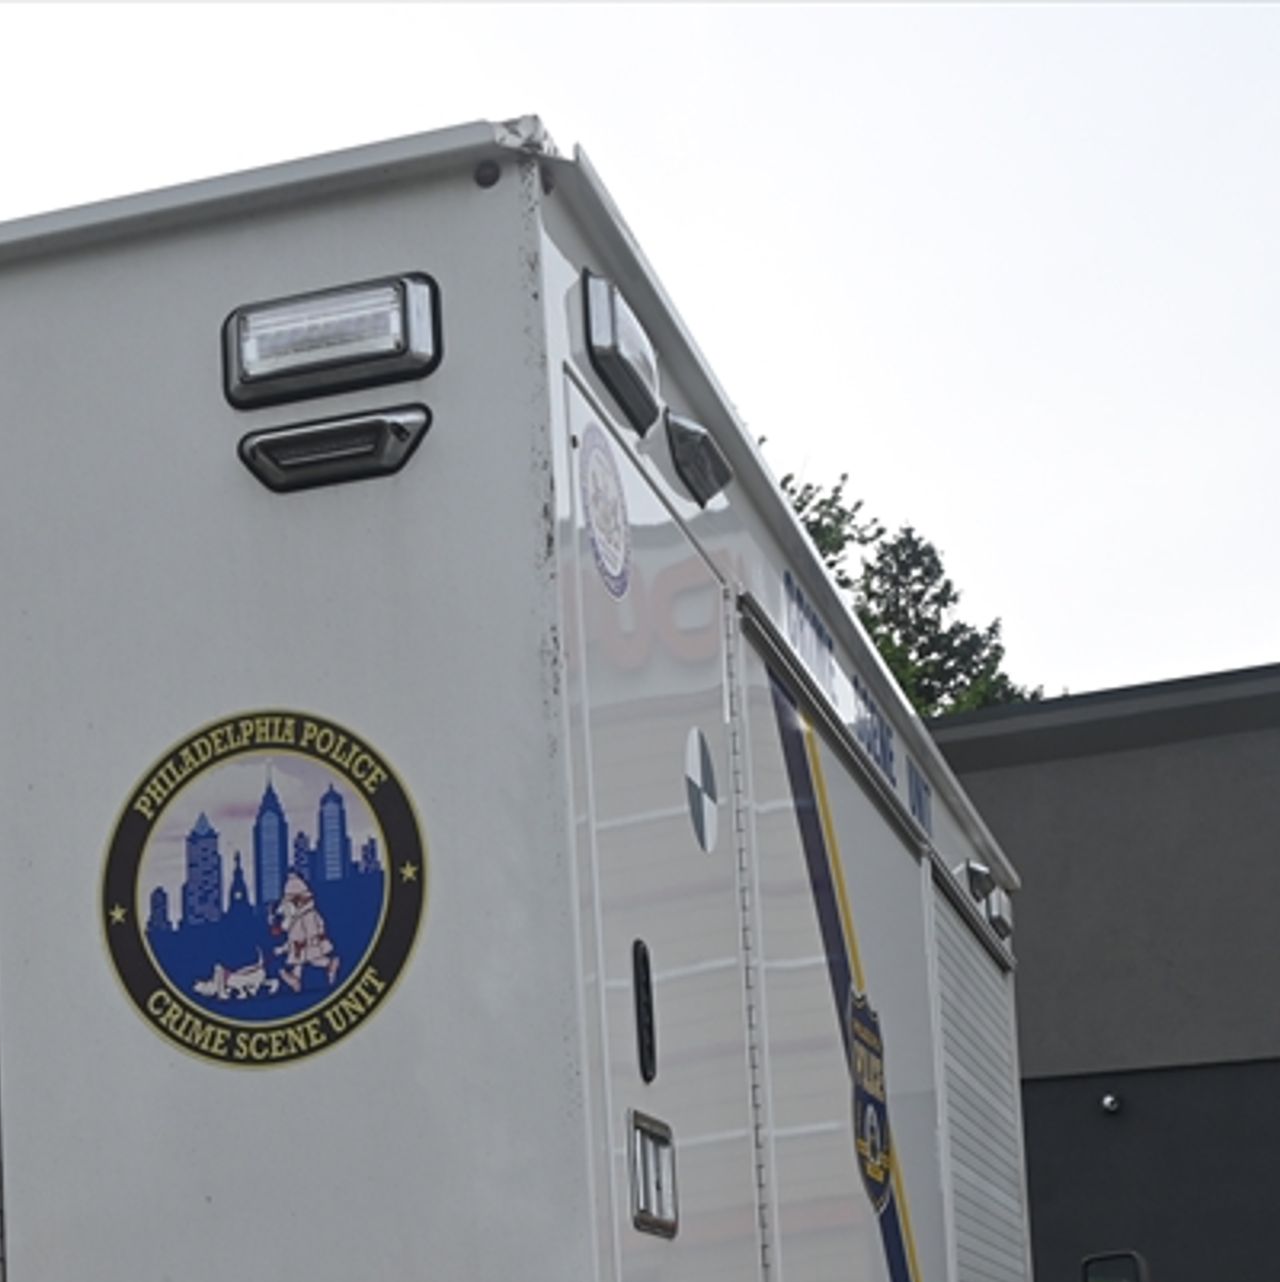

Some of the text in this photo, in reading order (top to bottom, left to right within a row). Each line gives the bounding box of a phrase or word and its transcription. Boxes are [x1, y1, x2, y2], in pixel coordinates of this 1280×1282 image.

[133, 716, 389, 820] PHILADELPHIA POLICE
[145, 966, 388, 1060] CRIME SCENE UNIT
